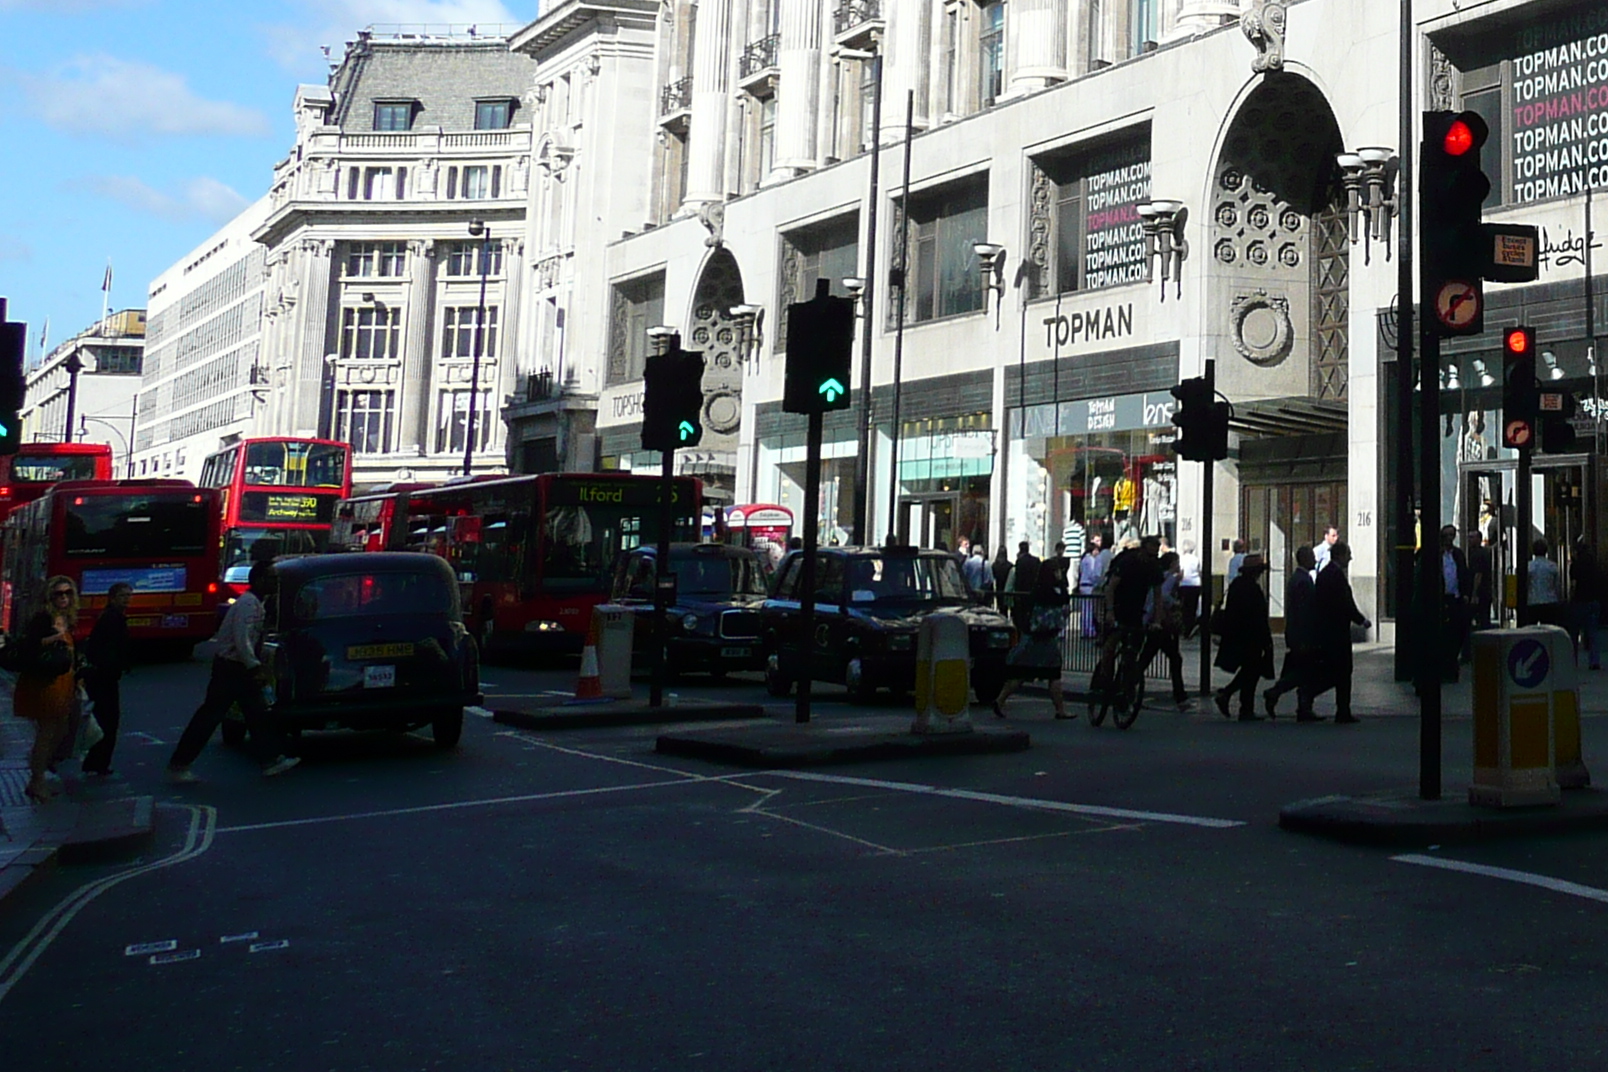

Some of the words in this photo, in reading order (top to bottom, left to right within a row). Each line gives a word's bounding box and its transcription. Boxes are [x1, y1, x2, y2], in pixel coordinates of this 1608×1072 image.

[1088, 162, 1151, 192] TOPMAN.COM
[1088, 181, 1151, 211] TOPMAN.COM
[1087, 204, 1141, 230] TOPMAN.C
[1087, 223, 1145, 251] TOPMAN.CO
[1043, 303, 1132, 348] TOPMAN
[613, 392, 645, 418] TOPSHO
[1087, 414, 1116, 430] DESIGN
[579, 486, 623, 503] Ilford
[1357, 511, 1372, 527] 216
